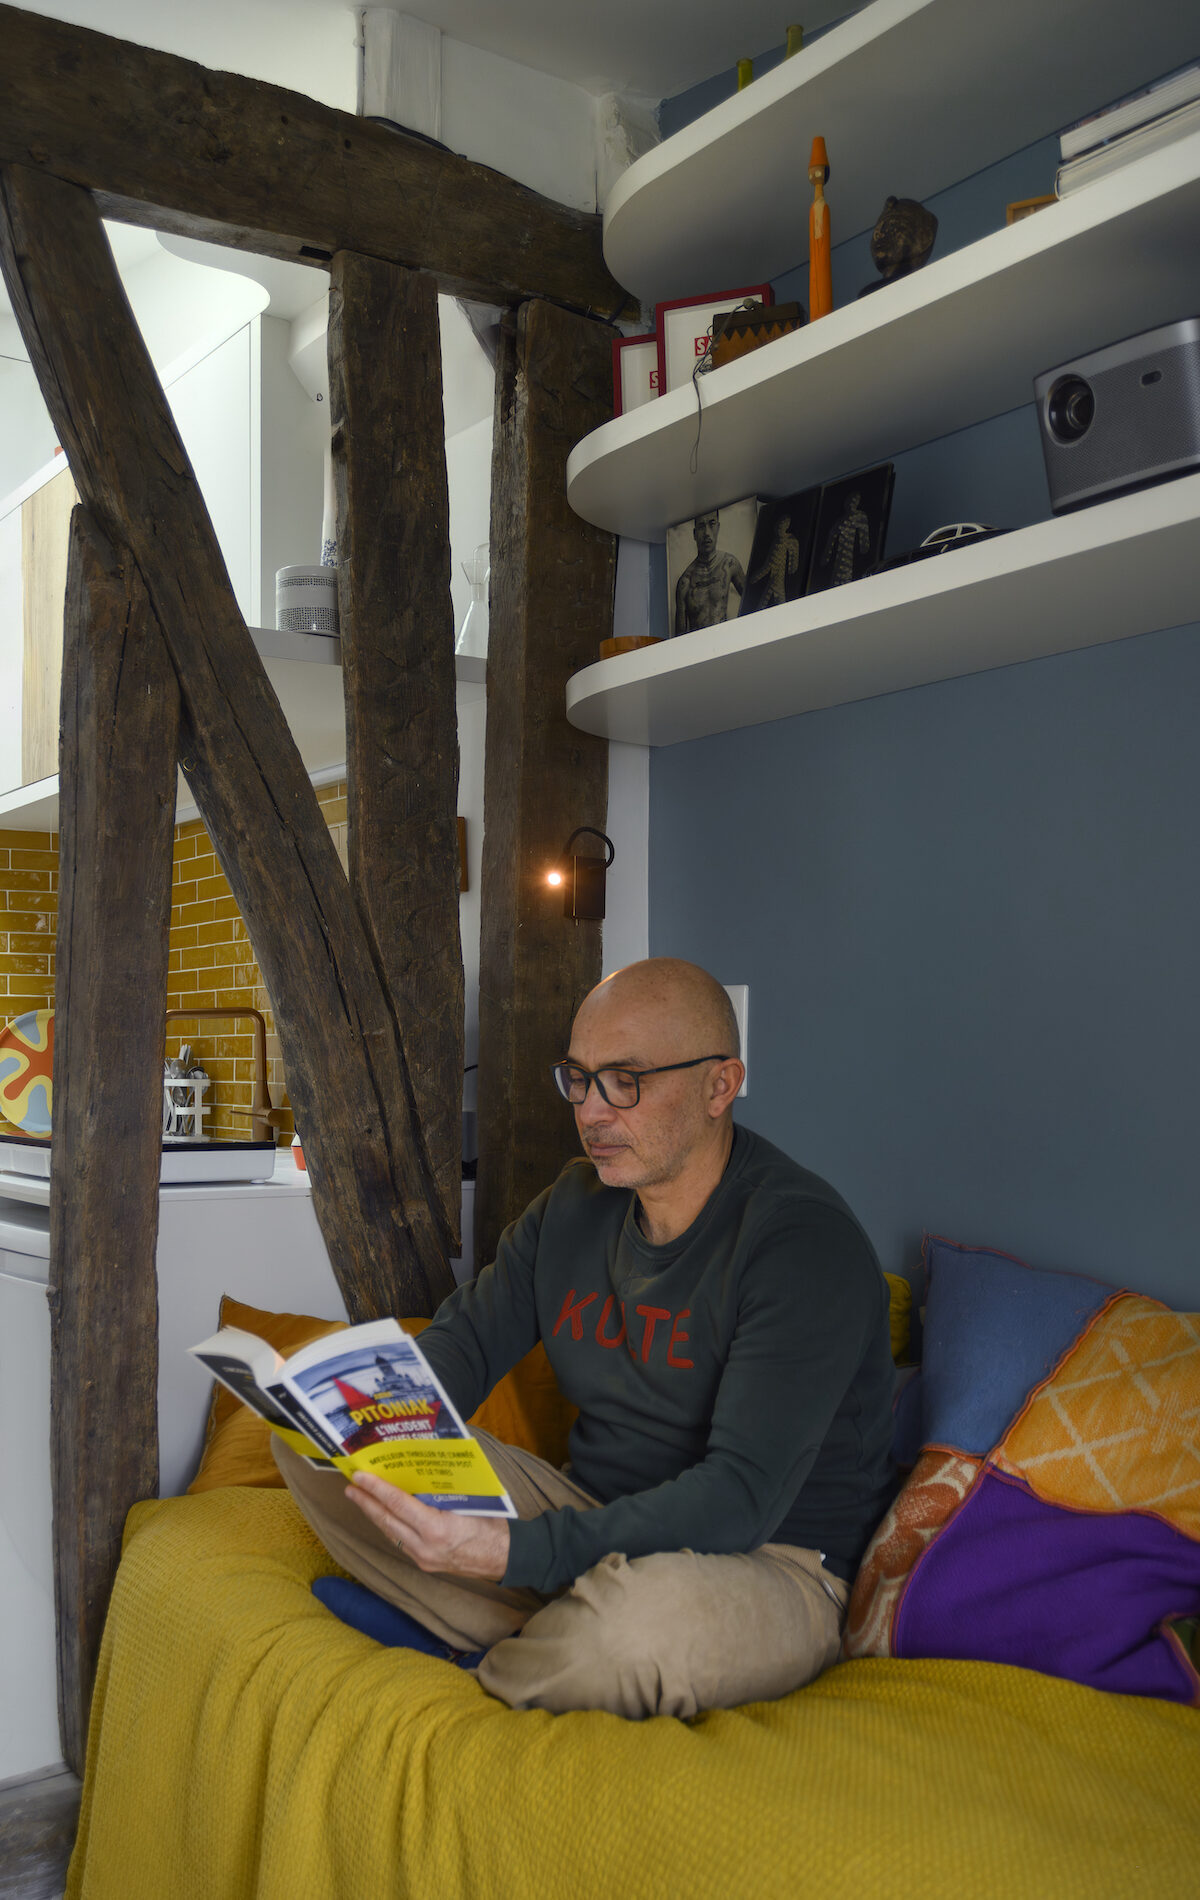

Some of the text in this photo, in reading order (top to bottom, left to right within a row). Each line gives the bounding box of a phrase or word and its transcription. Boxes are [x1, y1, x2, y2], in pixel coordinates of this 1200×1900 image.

[552, 1289, 694, 1369] KUTE
[349, 1398, 435, 1426] PITONIAK
[375, 1420, 432, 1436] L'INCIDENT
